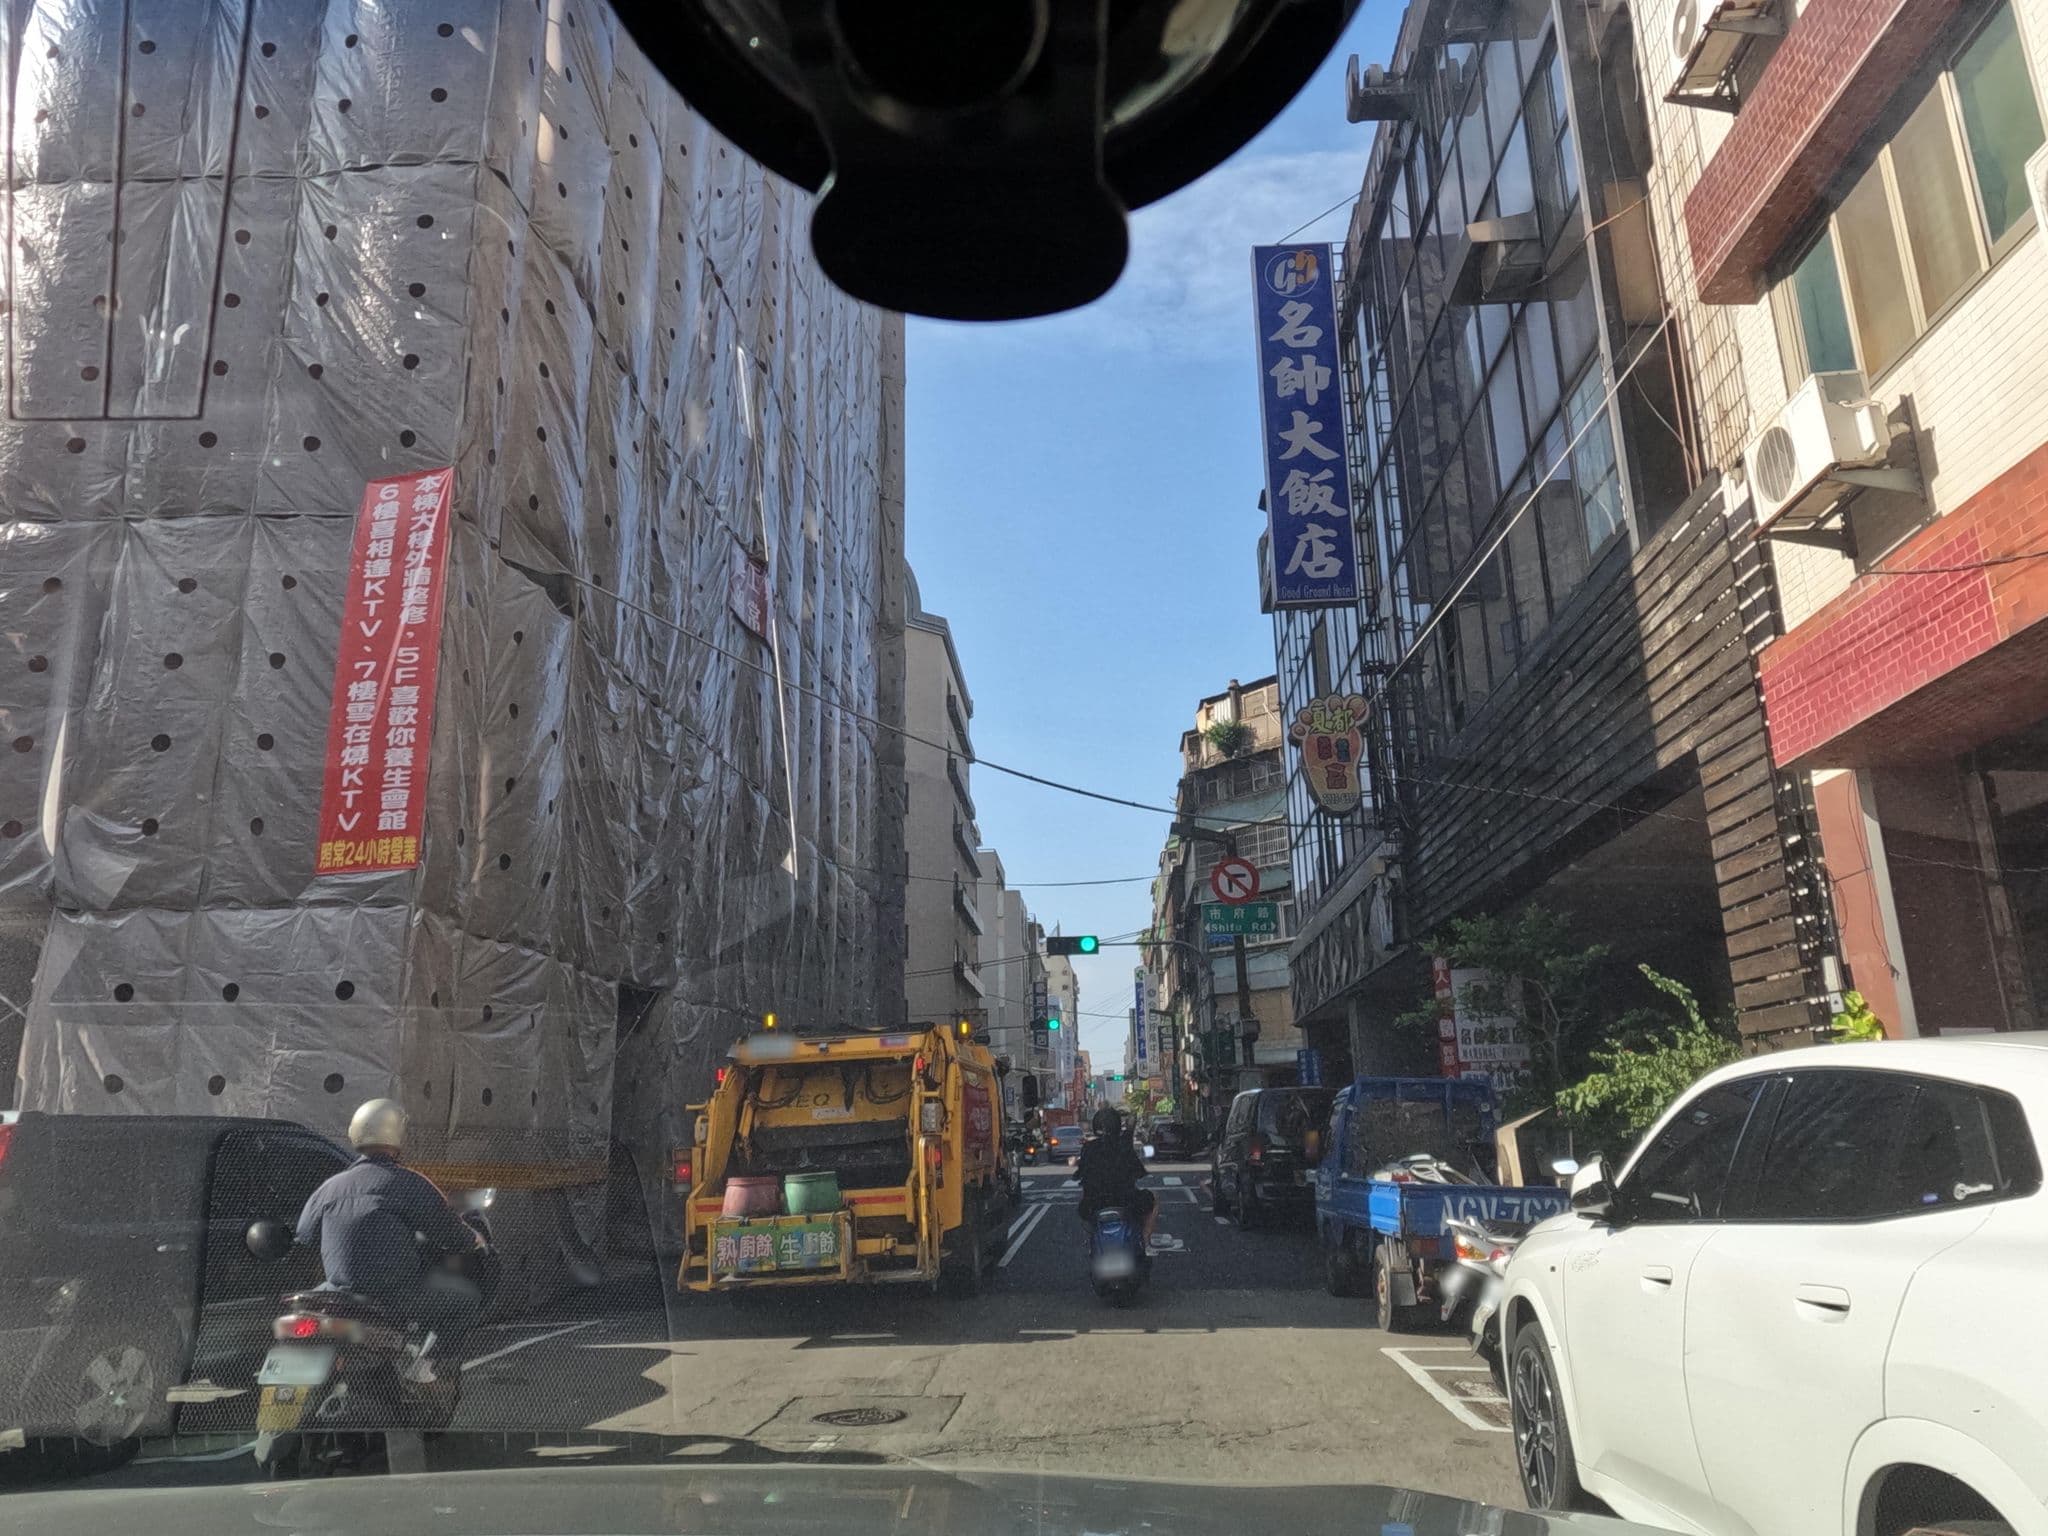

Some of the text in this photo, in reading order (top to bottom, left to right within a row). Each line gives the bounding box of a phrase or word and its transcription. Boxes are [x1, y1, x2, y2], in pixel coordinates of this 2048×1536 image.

[1269, 300, 1349, 579] 名帥大飯店
[1310, 702, 1356, 734] 夏都
[319, 836, 418, 868] 照常24小時營業
[1209, 906, 1269, 920] 市府路
[1211, 922, 1243, 932] Shifu
[716, 1233, 774, 1268] 熟廚餘
[779, 1231, 836, 1267] 生廚餘
